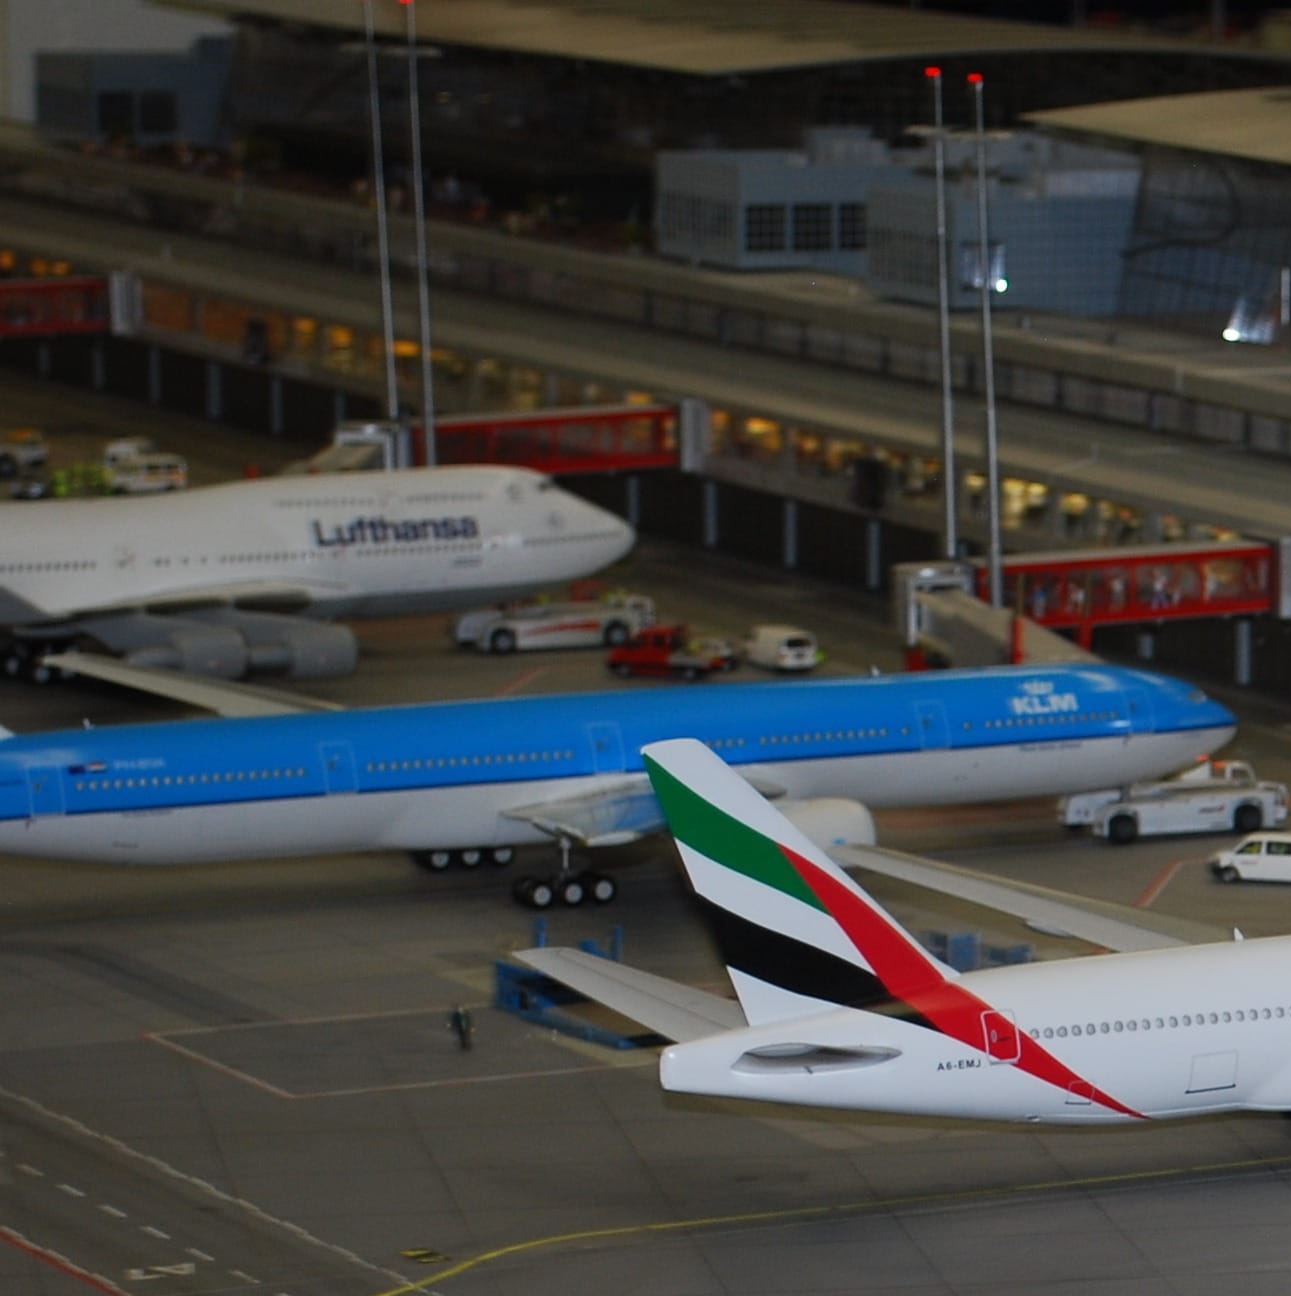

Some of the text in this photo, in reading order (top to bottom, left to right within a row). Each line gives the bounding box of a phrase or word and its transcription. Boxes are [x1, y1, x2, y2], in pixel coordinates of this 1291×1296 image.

[312, 516, 479, 546] Lufthansa
[1012, 692, 1079, 714] KLM
[936, 1059, 982, 1072] A6-EMJ
